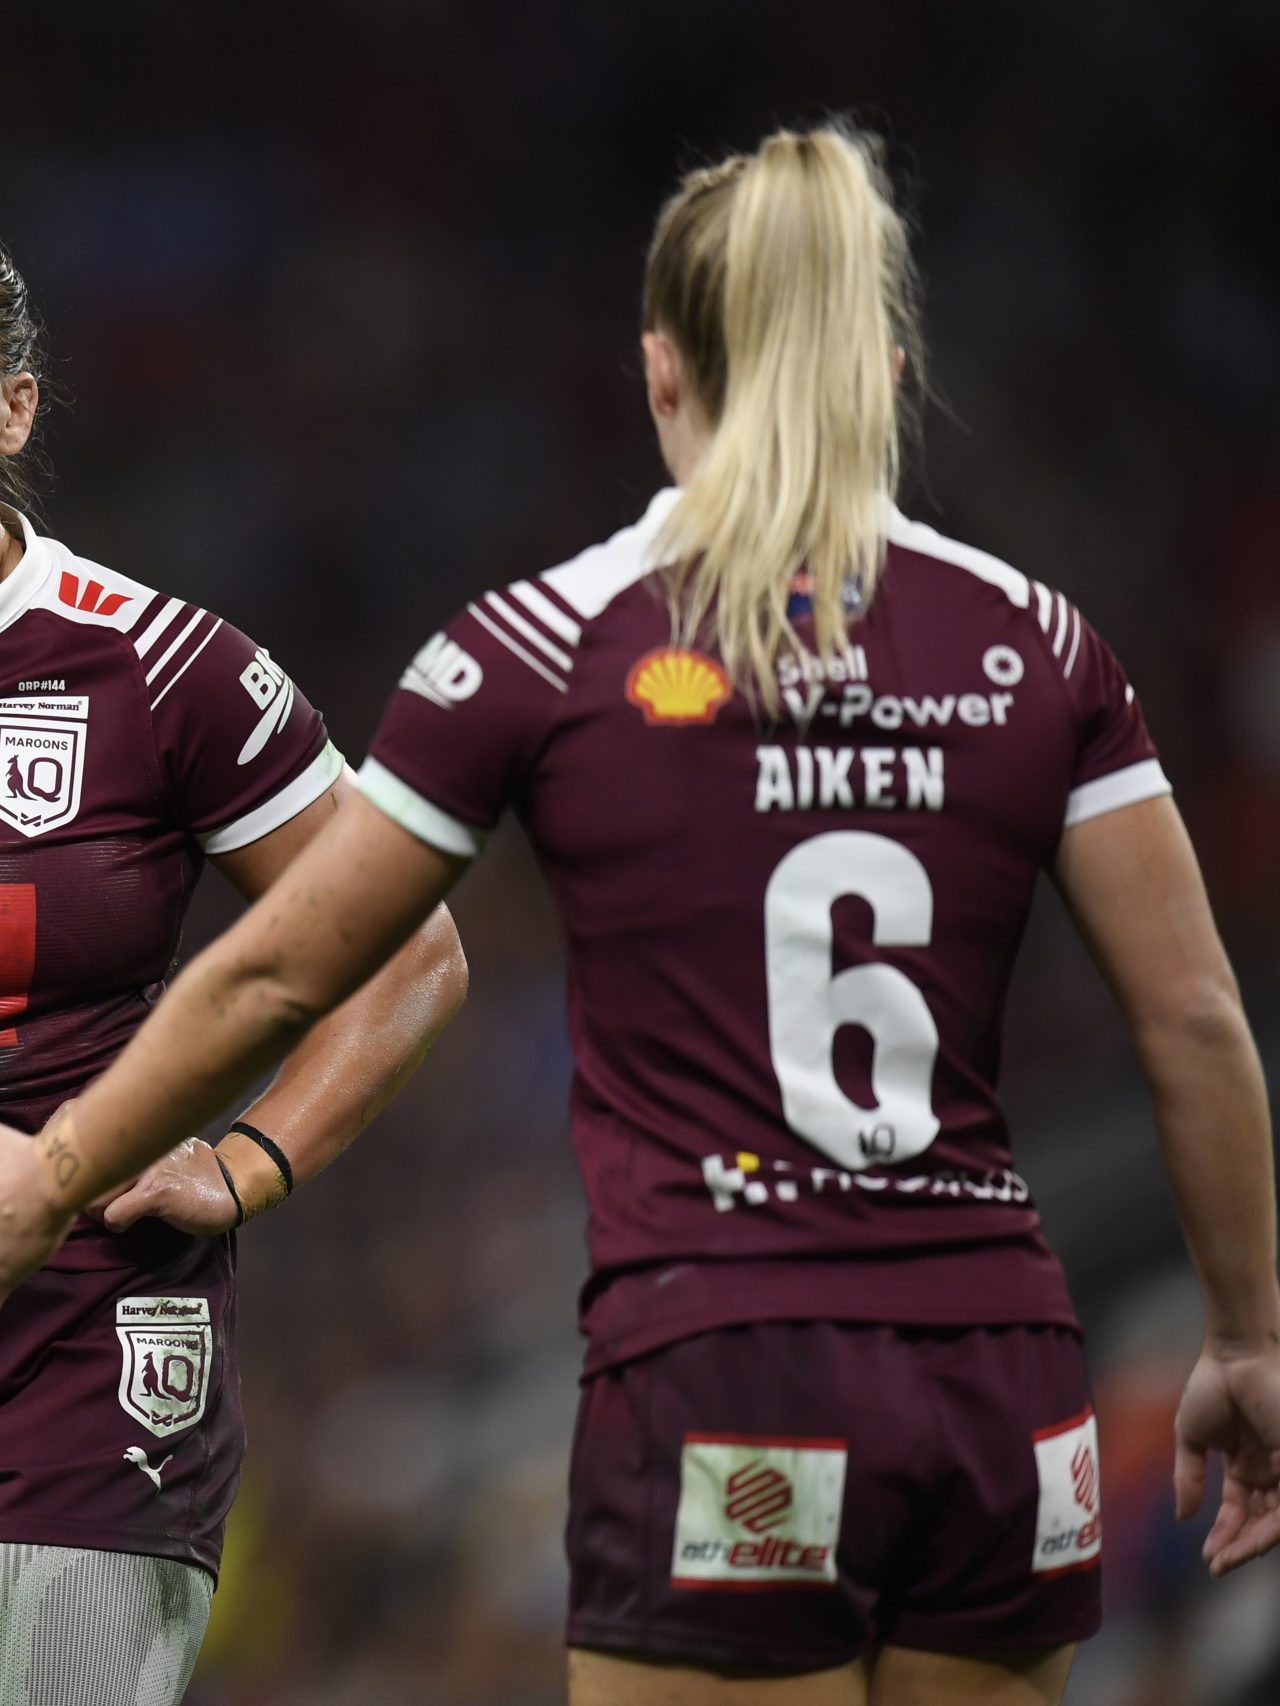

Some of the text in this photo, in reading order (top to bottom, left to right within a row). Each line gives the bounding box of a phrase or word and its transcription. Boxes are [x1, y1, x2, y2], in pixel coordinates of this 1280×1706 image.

[18, 679, 66, 691] QRP#144
[38, 702, 80, 712] Norman
[782, 683, 1015, 730] V-Power
[5, 736, 69, 751] MAROONS
[754, 744, 945, 812] AIKEN
[764, 829, 941, 1171] 6
